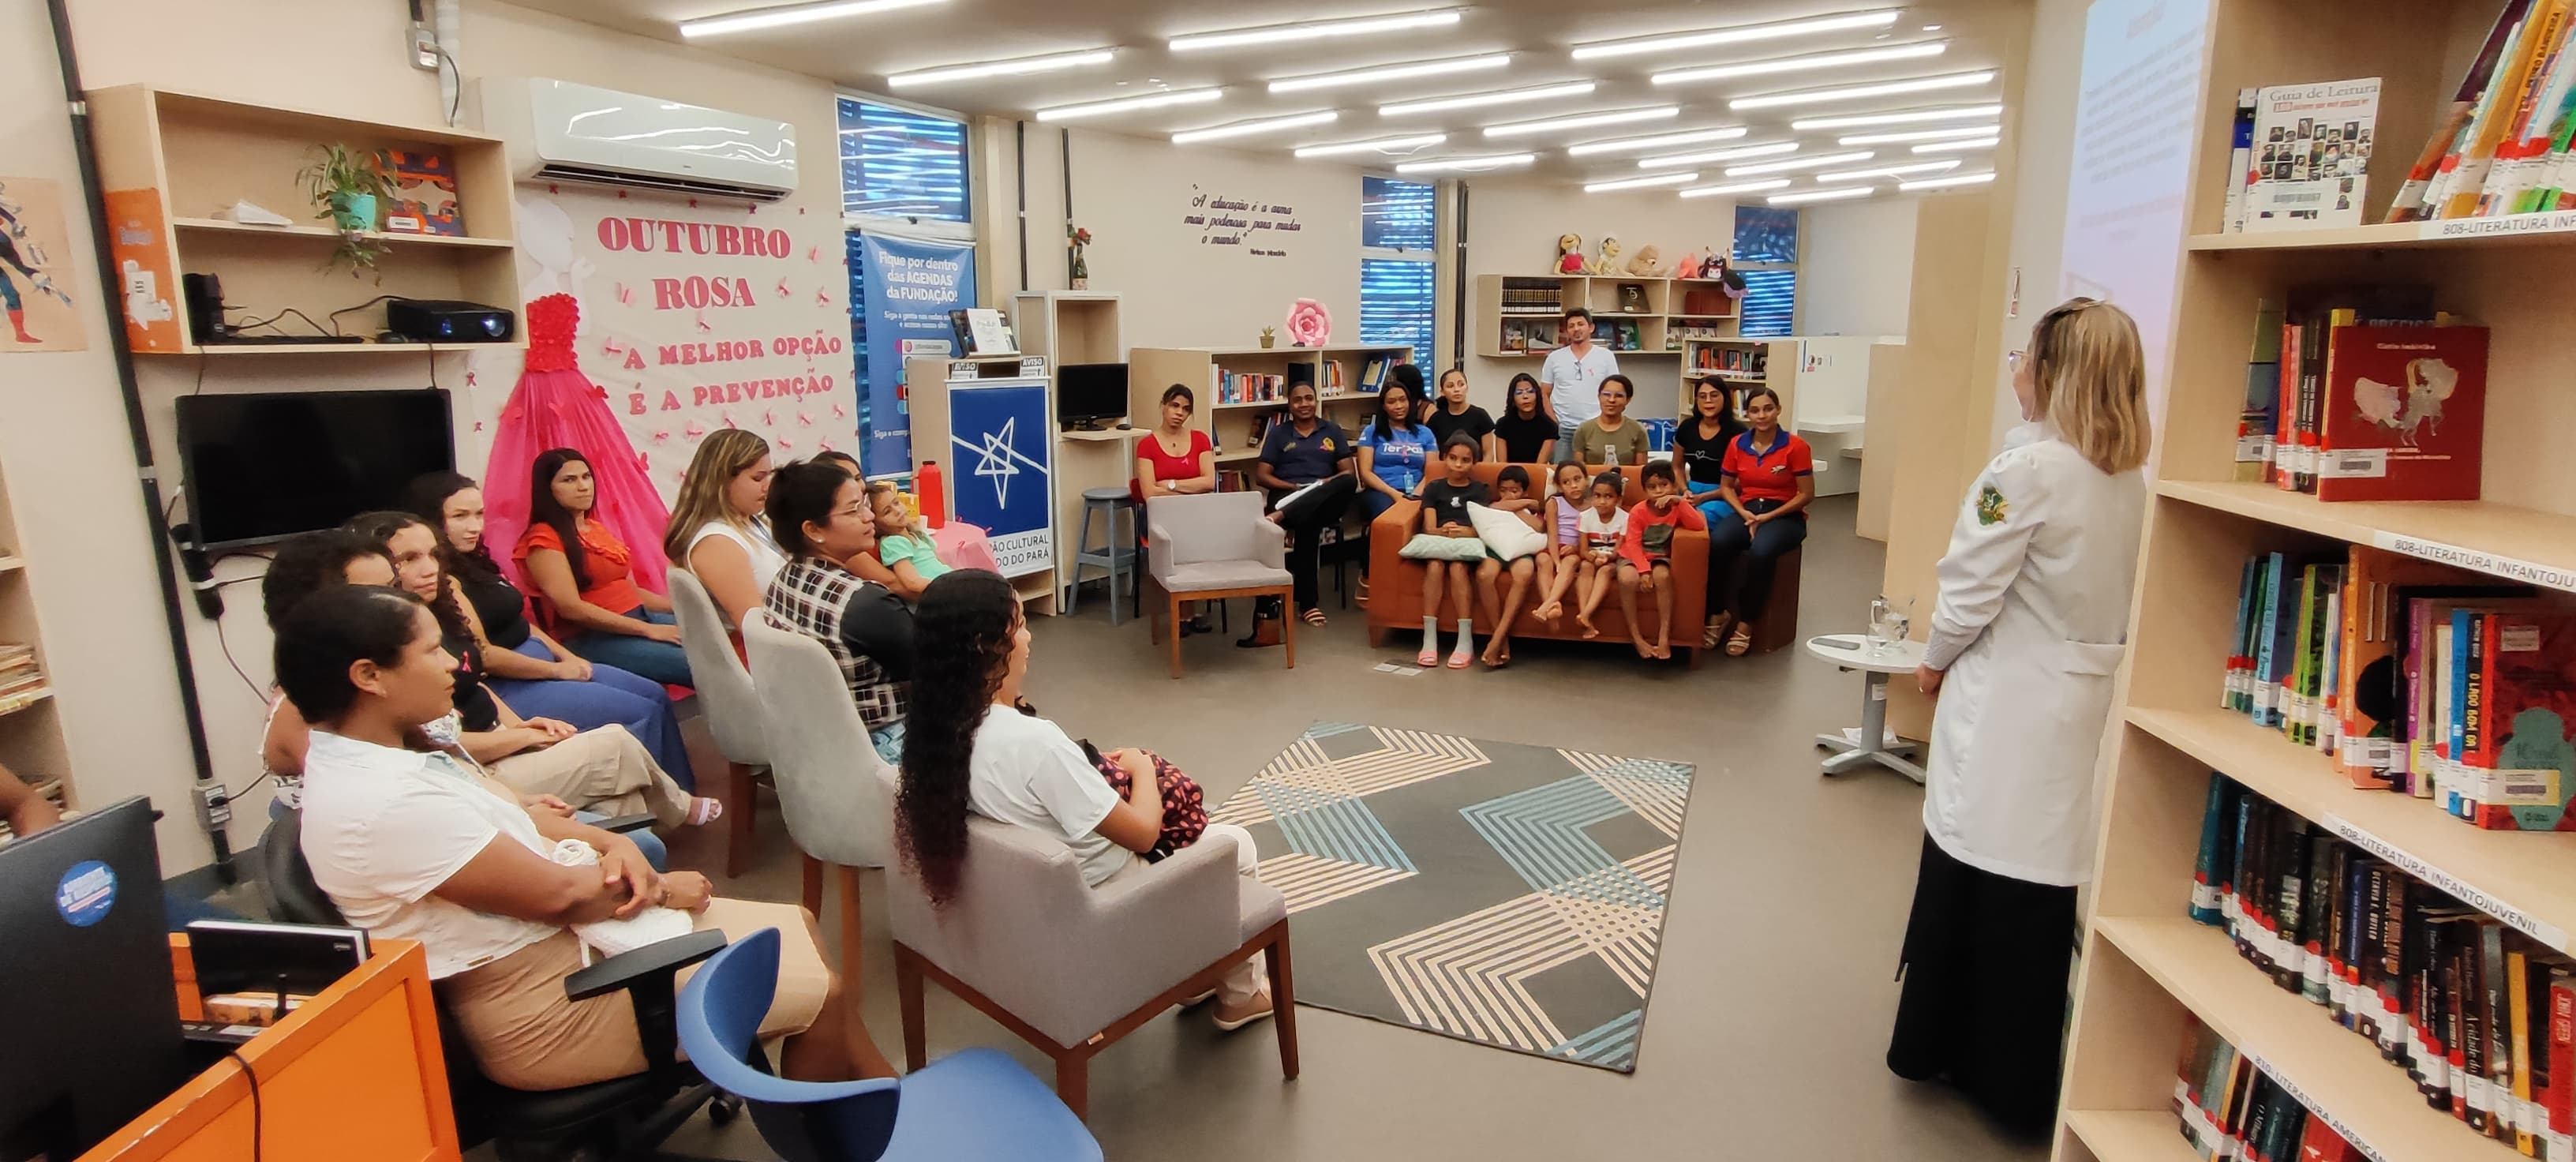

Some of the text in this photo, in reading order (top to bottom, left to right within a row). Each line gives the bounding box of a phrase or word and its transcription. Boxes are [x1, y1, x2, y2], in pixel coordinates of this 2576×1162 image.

[2270, 84, 2378, 102] Guia de Leitura
[1210, 196, 1249, 212] educação
[1252, 201, 1259, 212] é
[1184, 214, 1205, 225] mais
[1204, 213, 1248, 231] poderosa
[1248, 219, 1271, 232] para
[2443, 217, 2548, 235] 808-LITERATURA
[597, 217, 792, 258] OUTUBRO
[1201, 235, 1208, 244] o
[878, 251, 959, 272] Fique por dentro
[887, 270, 953, 287] das AGENDAS
[652, 276, 756, 310] ROSA
[886, 286, 958, 305] da FUNDAÇÃO!
[623, 329, 842, 370] A MELHOR OPÇÃO
[1022, 358, 1043, 367] AVISO
[628, 368, 834, 415] É A PREVENÇÃO
[1006, 534, 1049, 551] CULTURAL
[1011, 553, 1024, 565] DO
[1027, 547, 1049, 563] PARÁ
[2394, 539, 2576, 587] 808-LITERATURA INFANTOJU
[2468, 682, 2480, 707] LADO
[2466, 709, 2478, 731] BOM
[2339, 825, 2428, 878] 808-LITERATURA
[2431, 871, 2540, 935] INFANTOJUVENIL
[2466, 1022, 2481, 1058] cidade
[2469, 1059, 2481, 1074] do
[2275, 1071, 2329, 1122] LITERATURA
